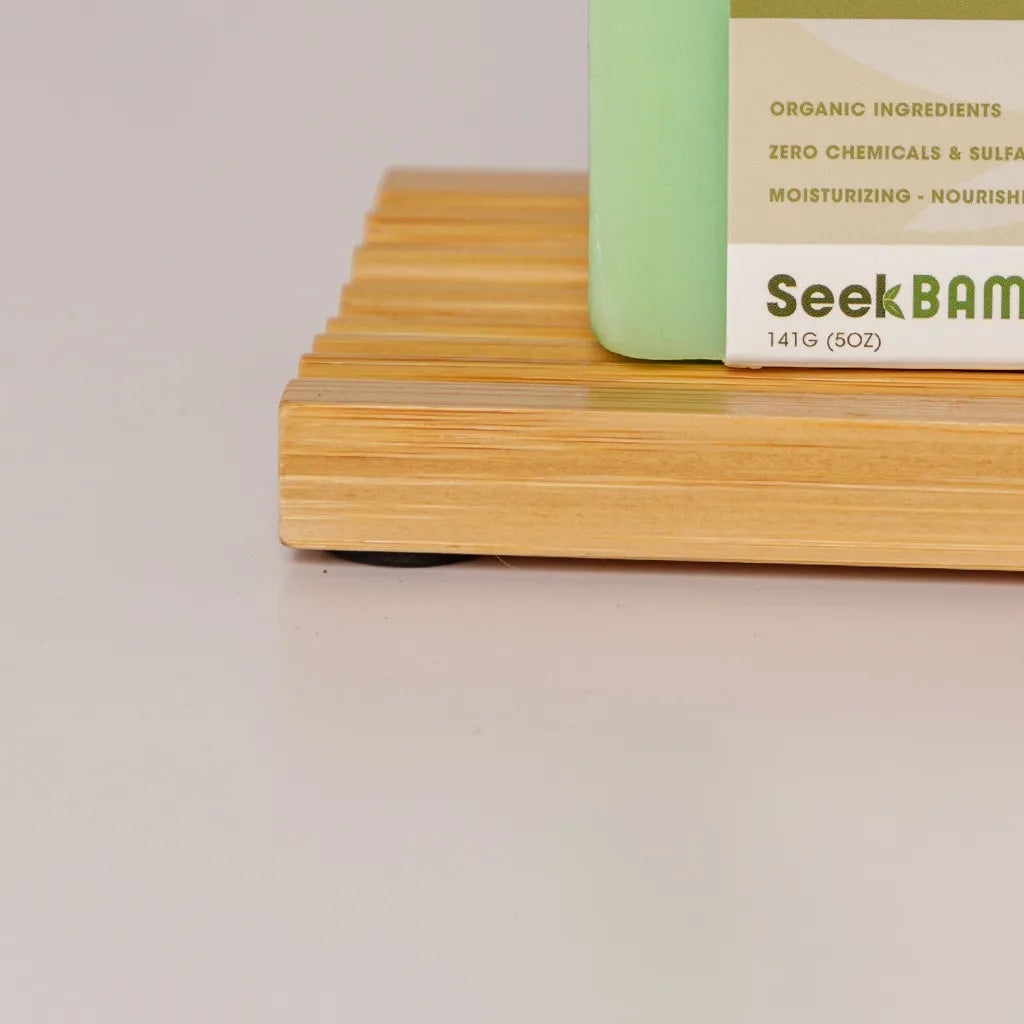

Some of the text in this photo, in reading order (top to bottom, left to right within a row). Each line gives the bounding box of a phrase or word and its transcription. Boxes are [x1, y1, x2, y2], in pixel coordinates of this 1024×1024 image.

[770, 102, 1002, 118] ORGANIC INGREDIENTS
[769, 145, 818, 160] ZERO
[825, 145, 941, 161] CHEMICALS
[948, 146, 961, 161] &
[769, 188, 911, 203] MOISTURIZING
[767, 331, 882, 352] 141G (5OZ)
